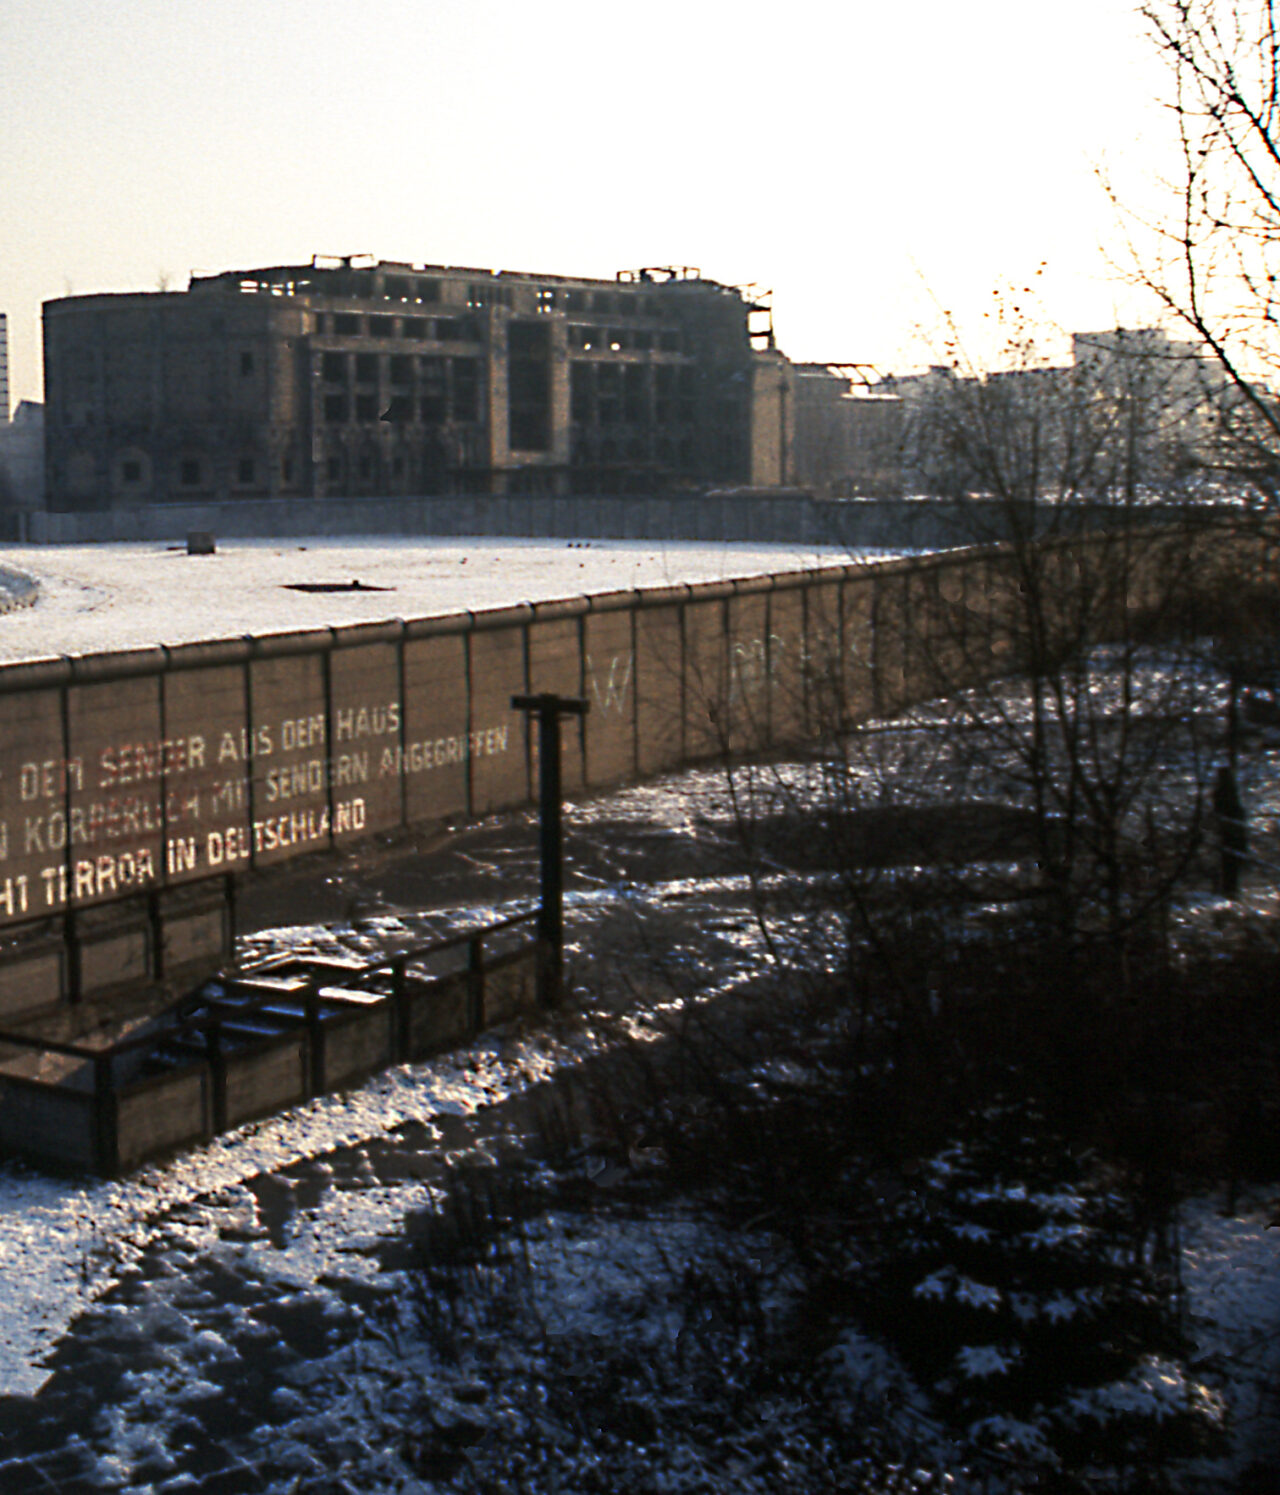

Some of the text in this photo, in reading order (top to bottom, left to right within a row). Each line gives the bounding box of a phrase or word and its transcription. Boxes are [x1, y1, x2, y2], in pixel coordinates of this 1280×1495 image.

[20, 755, 83, 801] DEM
[218, 726, 273, 764] AUS
[281, 713, 325, 751] DEM
[336, 702, 400, 741] HAUS
[167, 836, 196, 875] IN
[207, 797, 366, 867] DEUTSCHLAND
